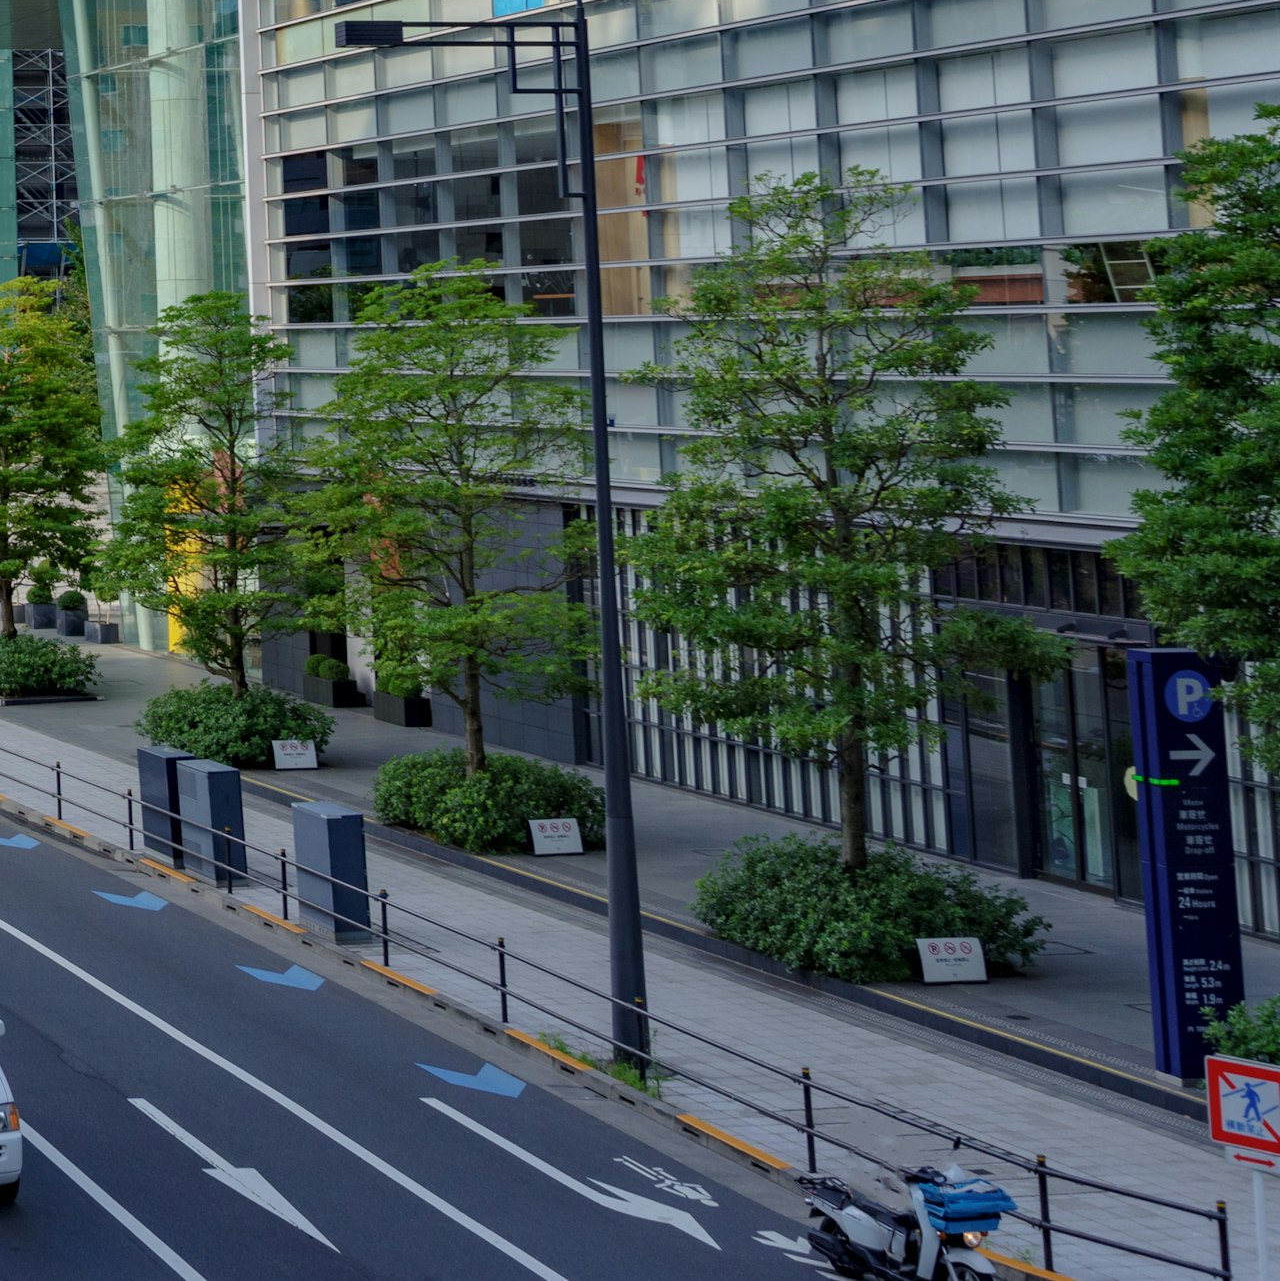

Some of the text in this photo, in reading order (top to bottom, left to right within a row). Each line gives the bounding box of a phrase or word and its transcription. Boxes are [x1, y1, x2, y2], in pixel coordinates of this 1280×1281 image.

[1176, 678, 1203, 715] P
[1178, 897, 1216, 909] 24 Hours
